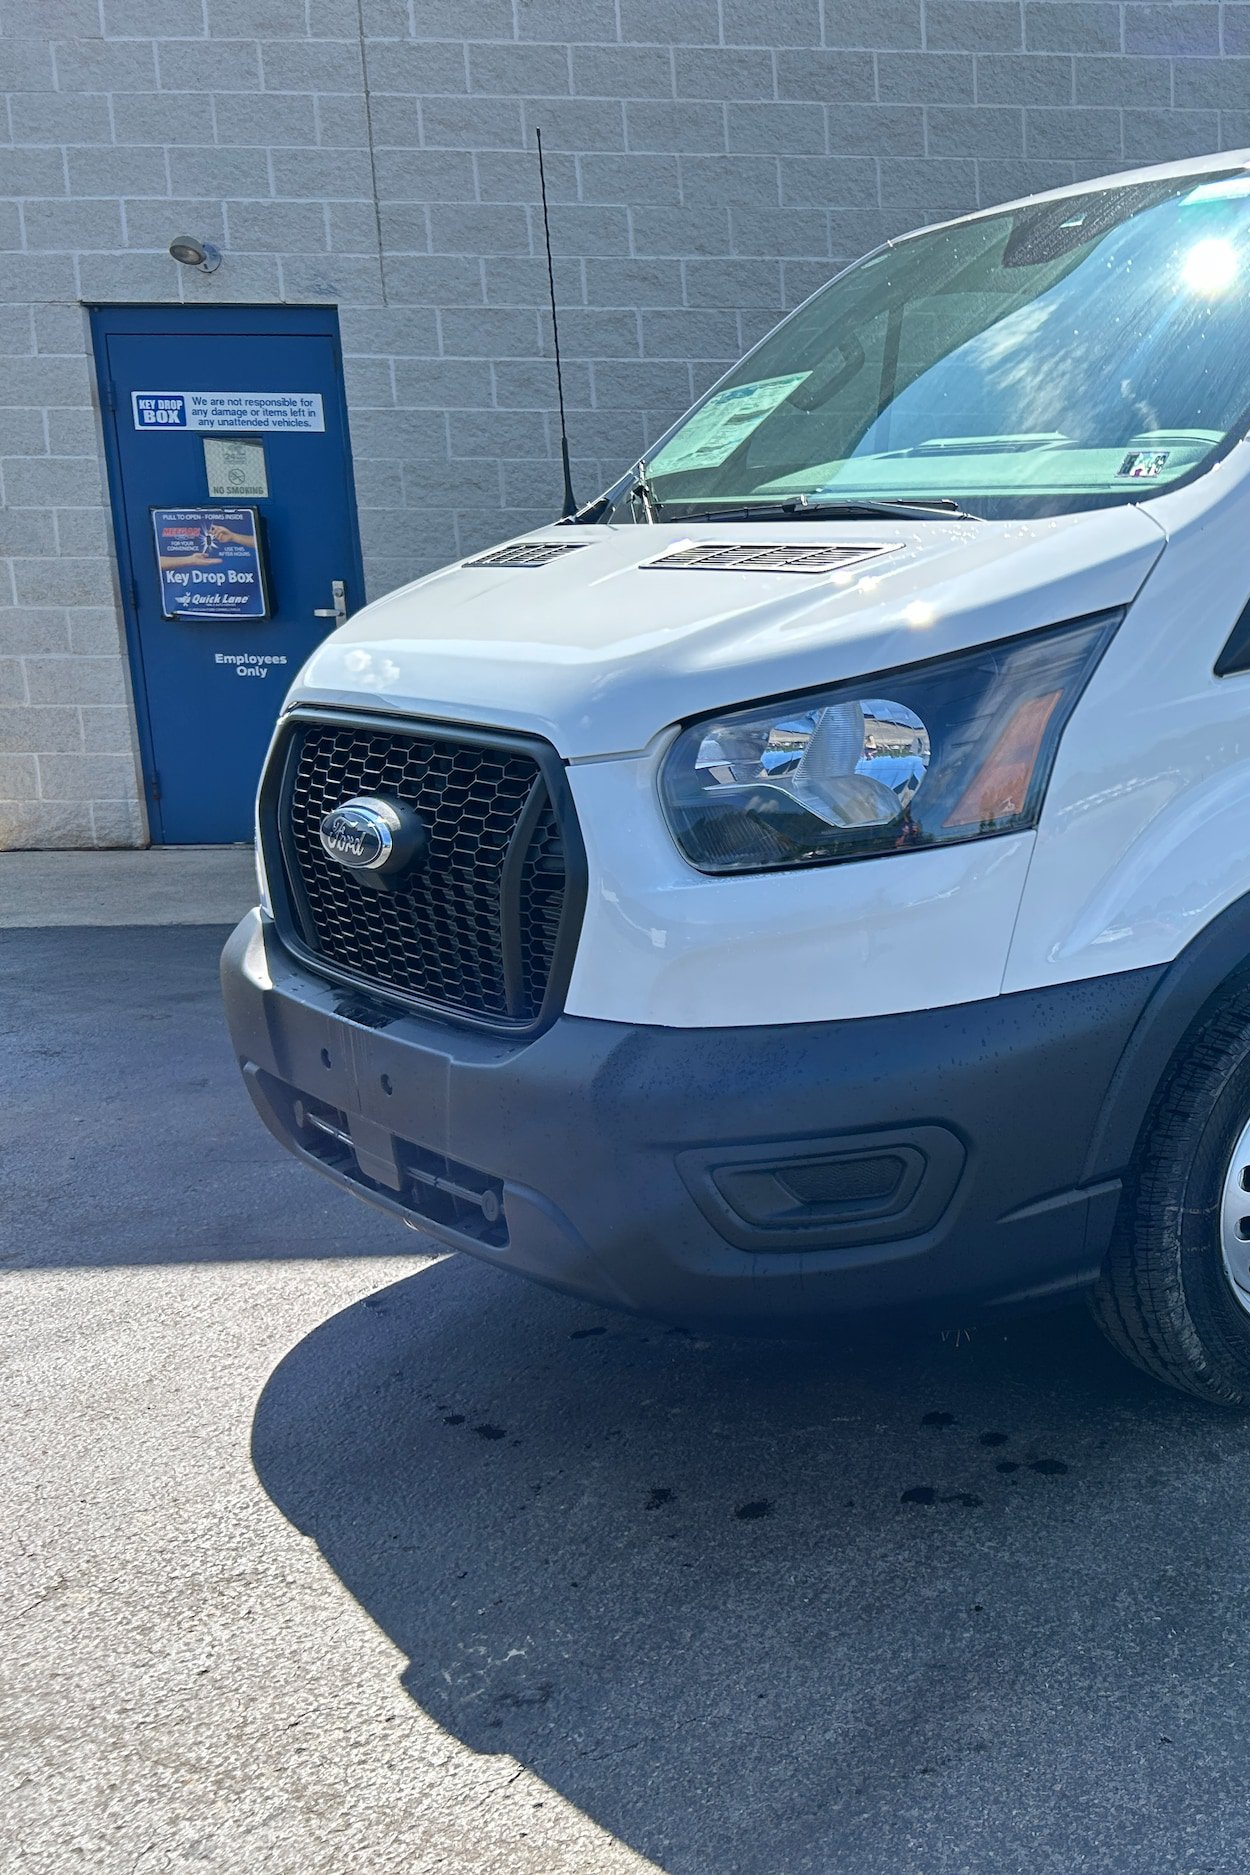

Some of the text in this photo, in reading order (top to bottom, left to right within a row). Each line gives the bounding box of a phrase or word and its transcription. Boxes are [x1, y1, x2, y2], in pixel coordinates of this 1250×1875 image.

[139, 399, 183, 410] KEY DROP
[192, 397, 208, 406] We
[245, 397, 297, 408] responsible
[300, 398, 313, 407] for
[143, 410, 180, 424] BOX
[192, 409, 208, 418] any
[211, 407, 248, 418] damage
[262, 408, 288, 417] items
[290, 408, 305, 417] left
[308, 408, 316, 417] in
[198, 418, 312, 428] any unattended vehicles.
[213, 486, 264, 495] NO SMOKING
[165, 570, 255, 586] Key Drop Box
[192, 594, 249, 605] Quick Lane
[214, 653, 288, 666] Employees
[236, 666, 268, 679] Only
[327, 815, 367, 856] Ford
